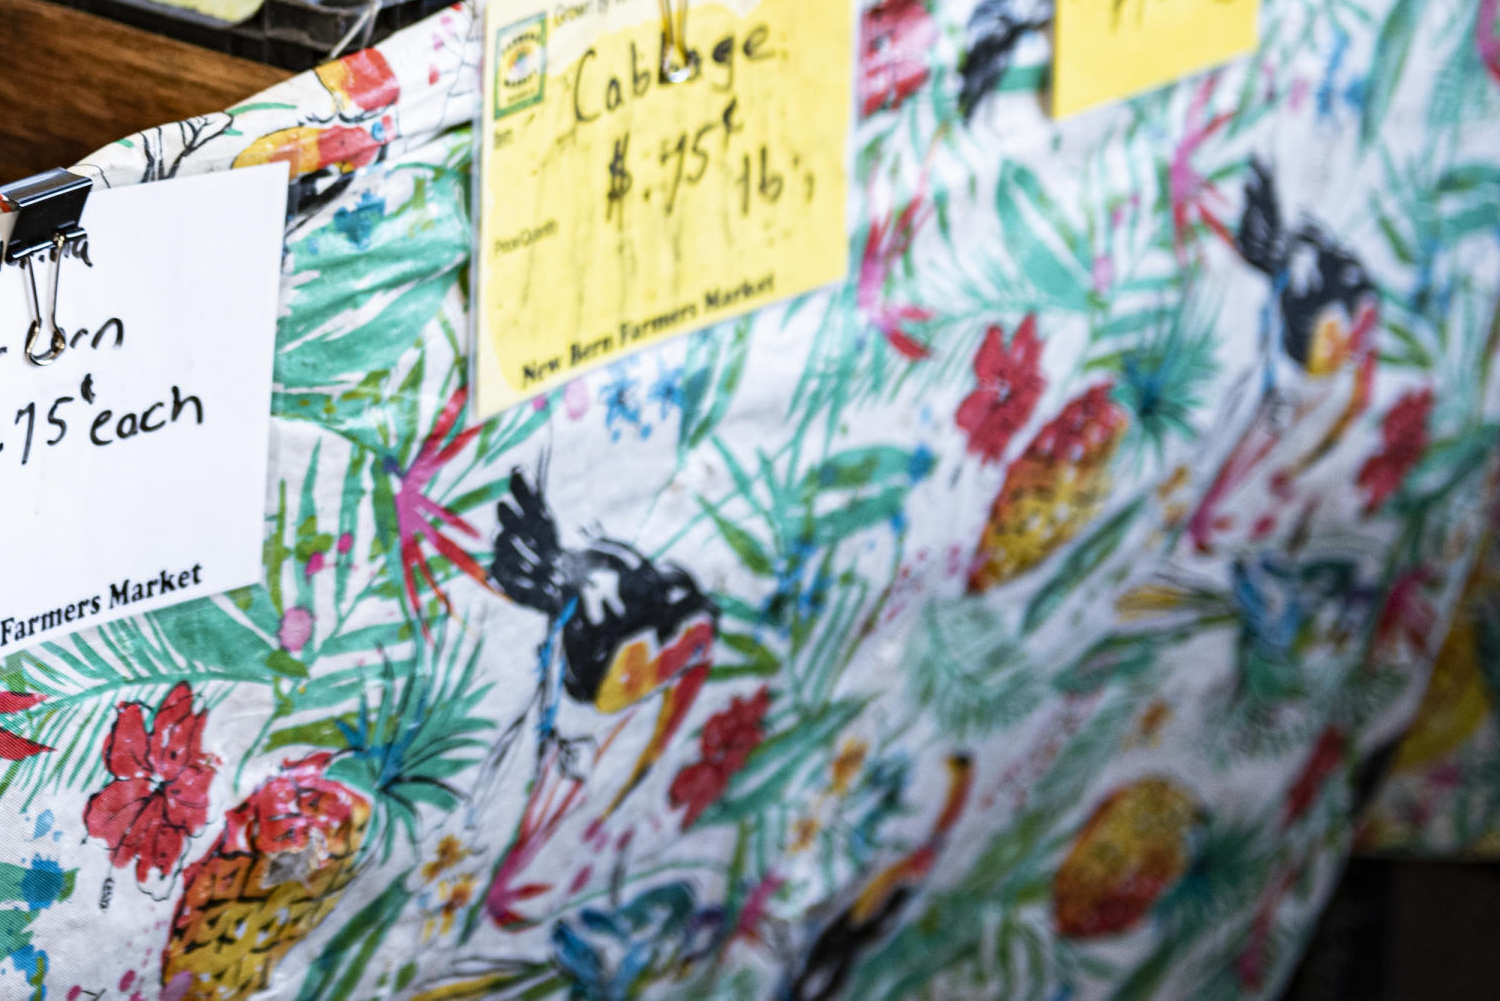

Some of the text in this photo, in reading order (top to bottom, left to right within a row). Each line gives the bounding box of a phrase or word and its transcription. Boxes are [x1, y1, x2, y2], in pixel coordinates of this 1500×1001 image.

[522, 274, 775, 388] New Bern Farmers Market
[90, 385, 204, 446] each
[0, 594, 101, 647] Farmers
[109, 562, 203, 609] Market
